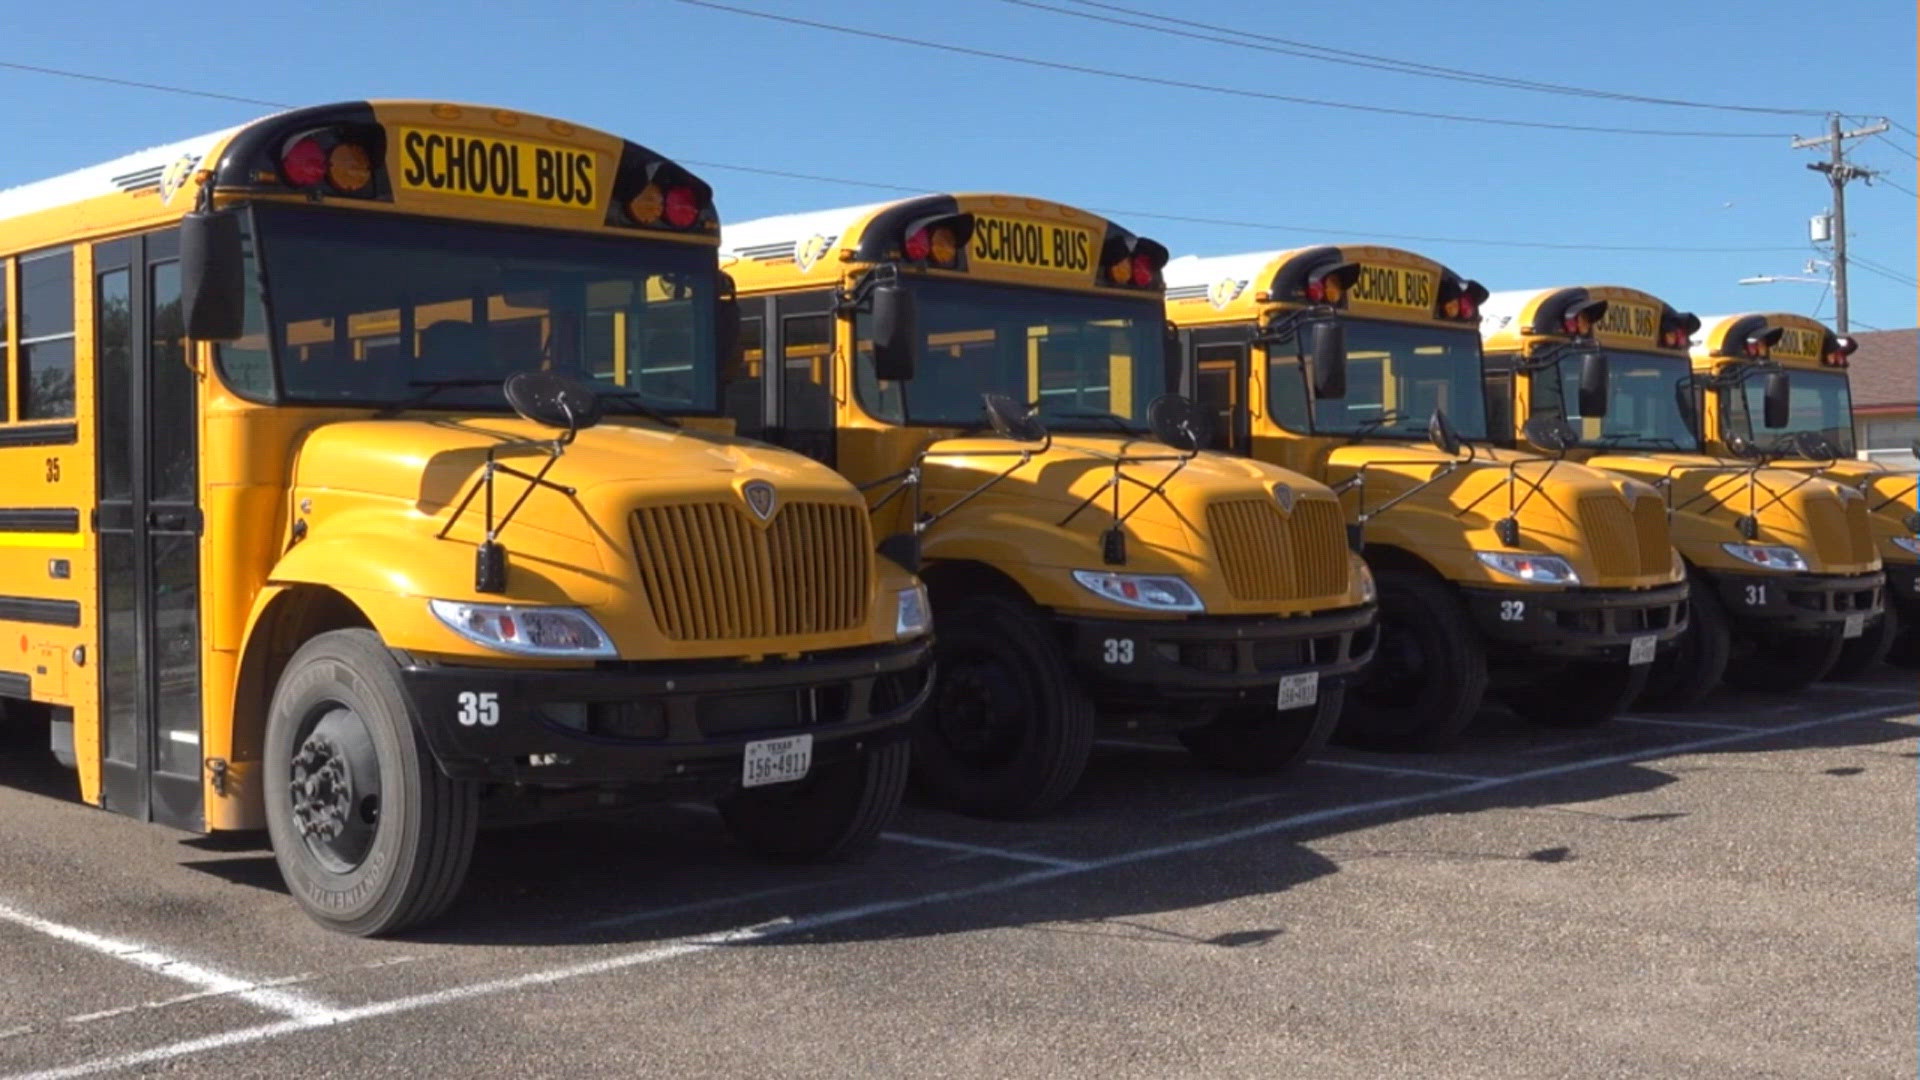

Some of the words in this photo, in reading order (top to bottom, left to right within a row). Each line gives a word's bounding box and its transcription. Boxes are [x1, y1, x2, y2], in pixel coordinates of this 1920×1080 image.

[404, 130, 529, 198] SCHOOL
[536, 148, 593, 205] BUS
[975, 217, 1049, 266] SCHOOL
[1053, 228, 1088, 271] BUS
[1405, 271, 1429, 307] BUS
[46, 457, 60, 482] 35
[1745, 584, 1767, 605] 31
[1500, 600, 1525, 621] 32
[1104, 638, 1134, 664] 33
[457, 691, 499, 726] 35
